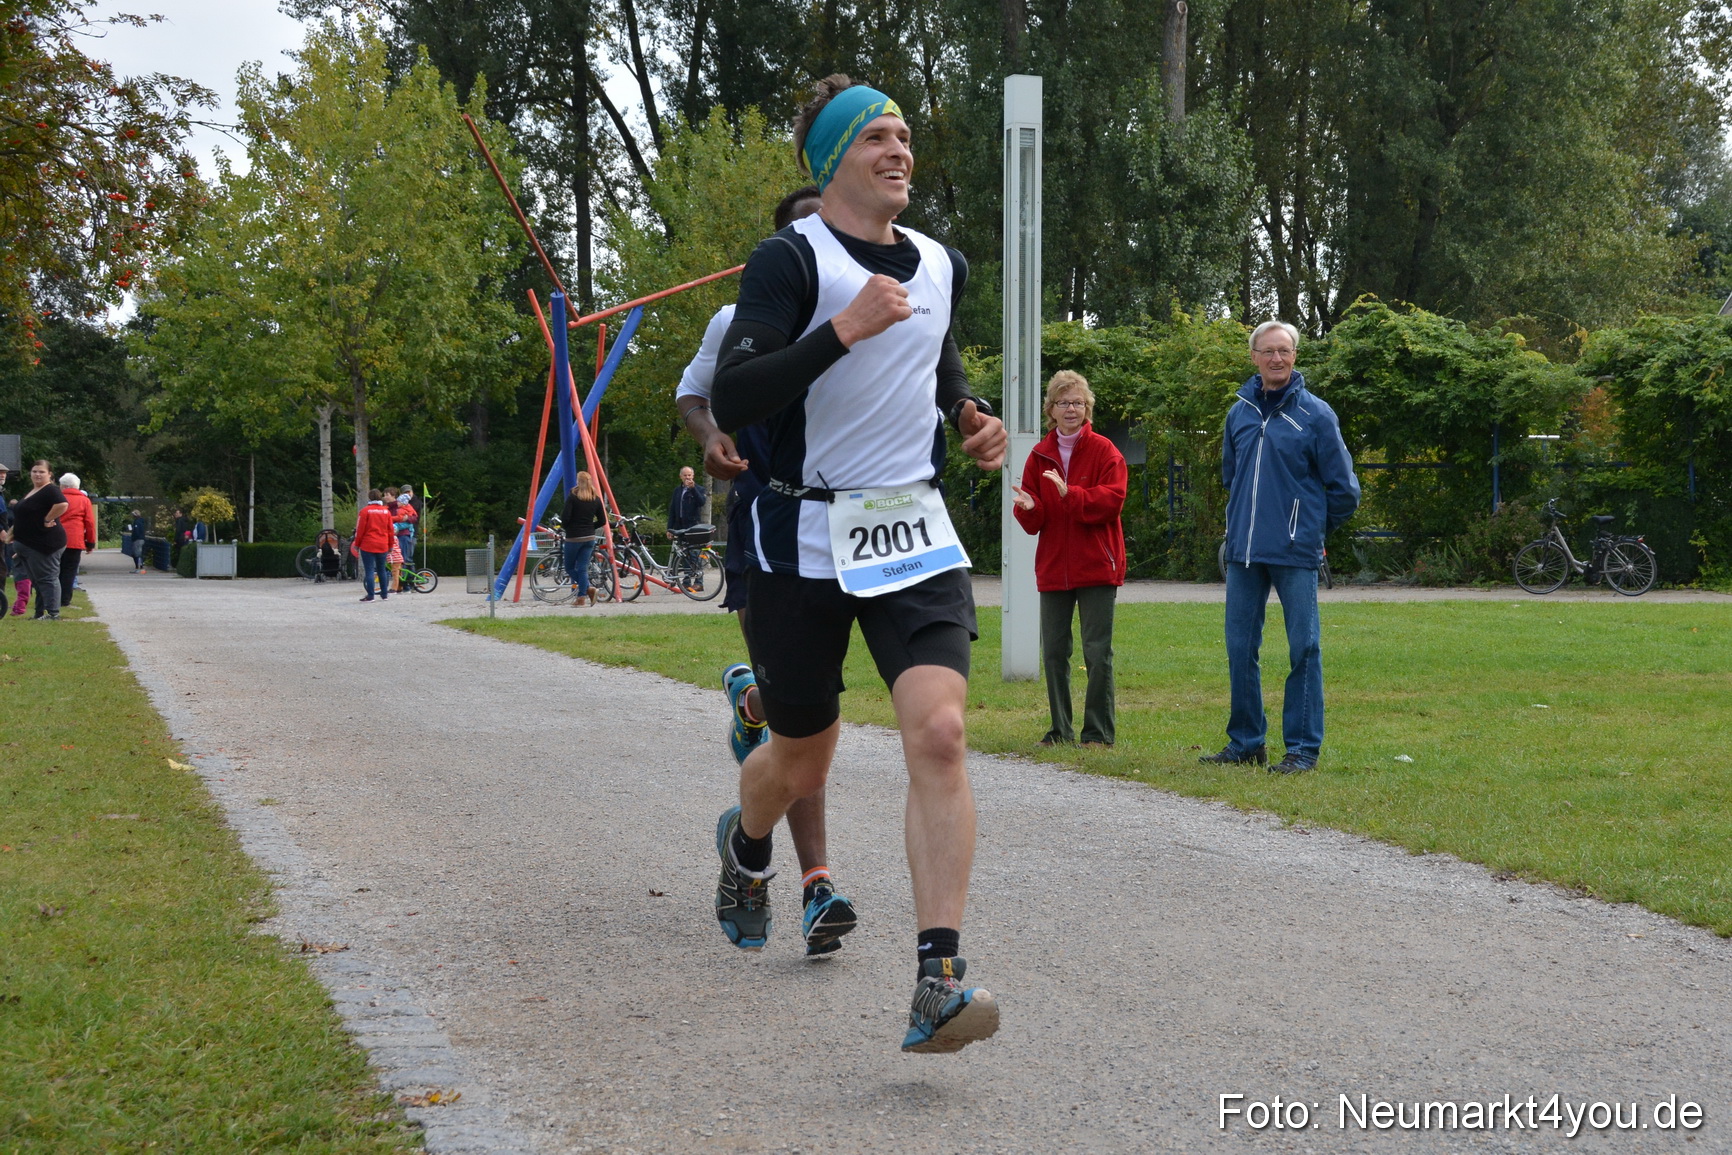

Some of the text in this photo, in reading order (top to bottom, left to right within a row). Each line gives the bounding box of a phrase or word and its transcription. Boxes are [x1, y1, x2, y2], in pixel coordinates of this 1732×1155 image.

[817, 102, 882, 187] DYNAFIT
[876, 494, 913, 509] BOCK
[849, 517, 932, 561] 2001
[882, 560, 923, 577] Stefan
